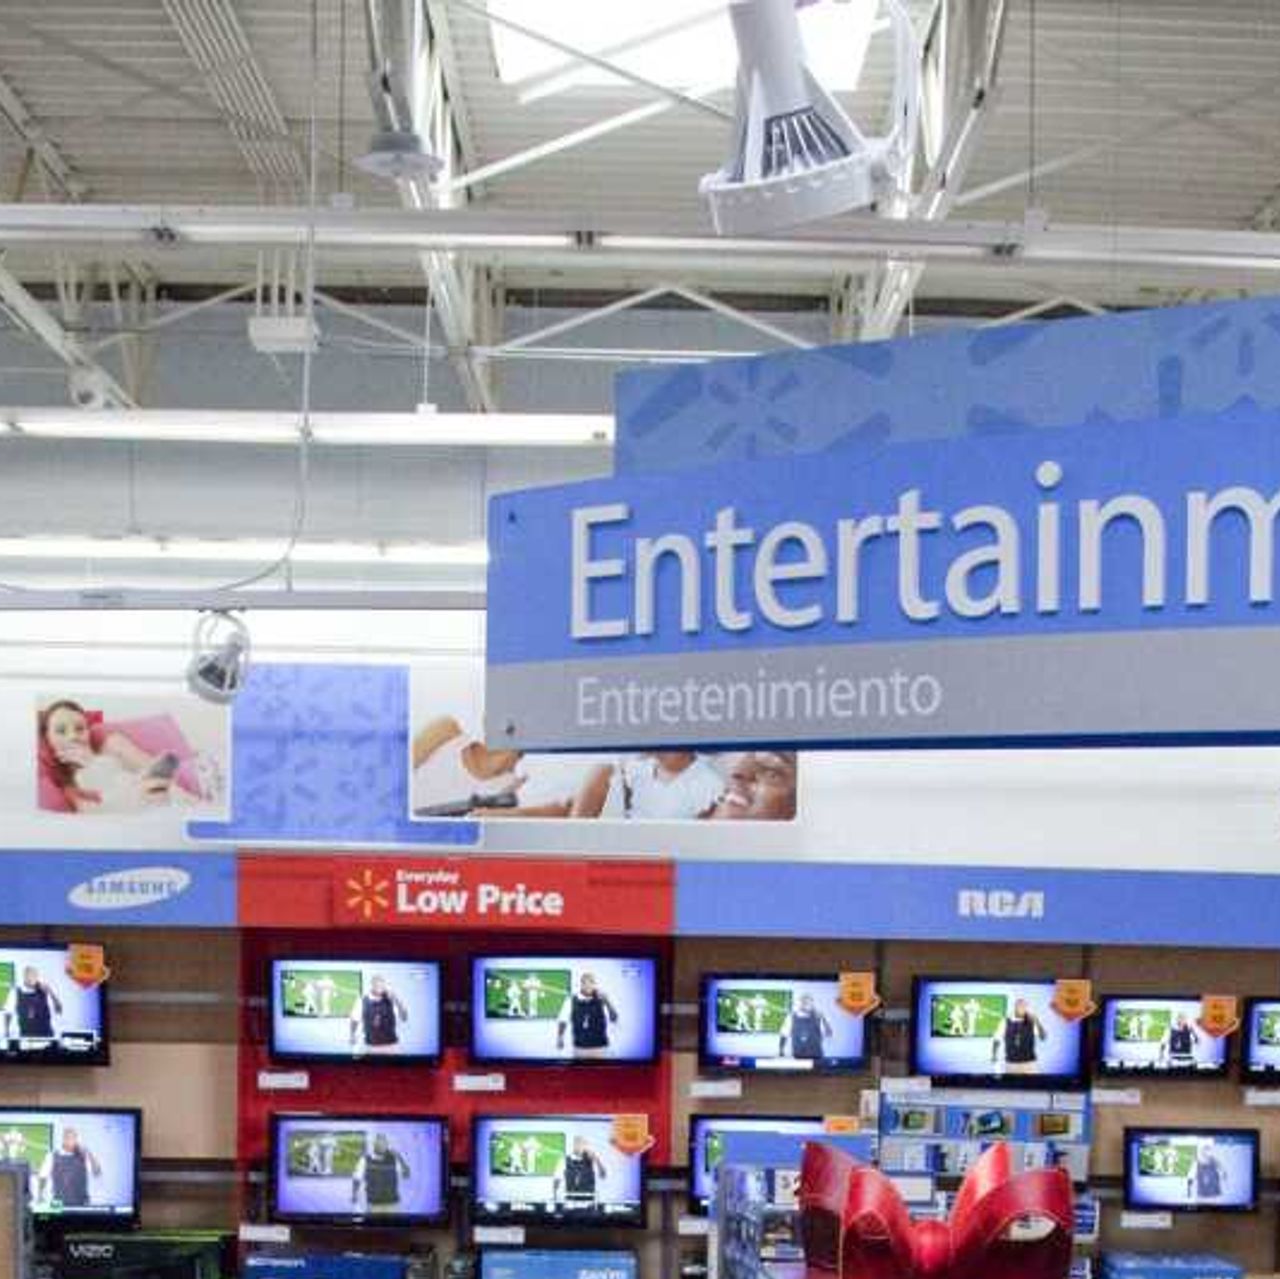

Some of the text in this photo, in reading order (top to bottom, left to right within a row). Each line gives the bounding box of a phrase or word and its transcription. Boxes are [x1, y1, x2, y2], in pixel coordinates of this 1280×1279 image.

[575, 667, 943, 727] Entretenimiento
[395, 869, 460, 884] Everyday
[396, 882, 565, 916] Low Price
[957, 889, 1046, 918] RCA
